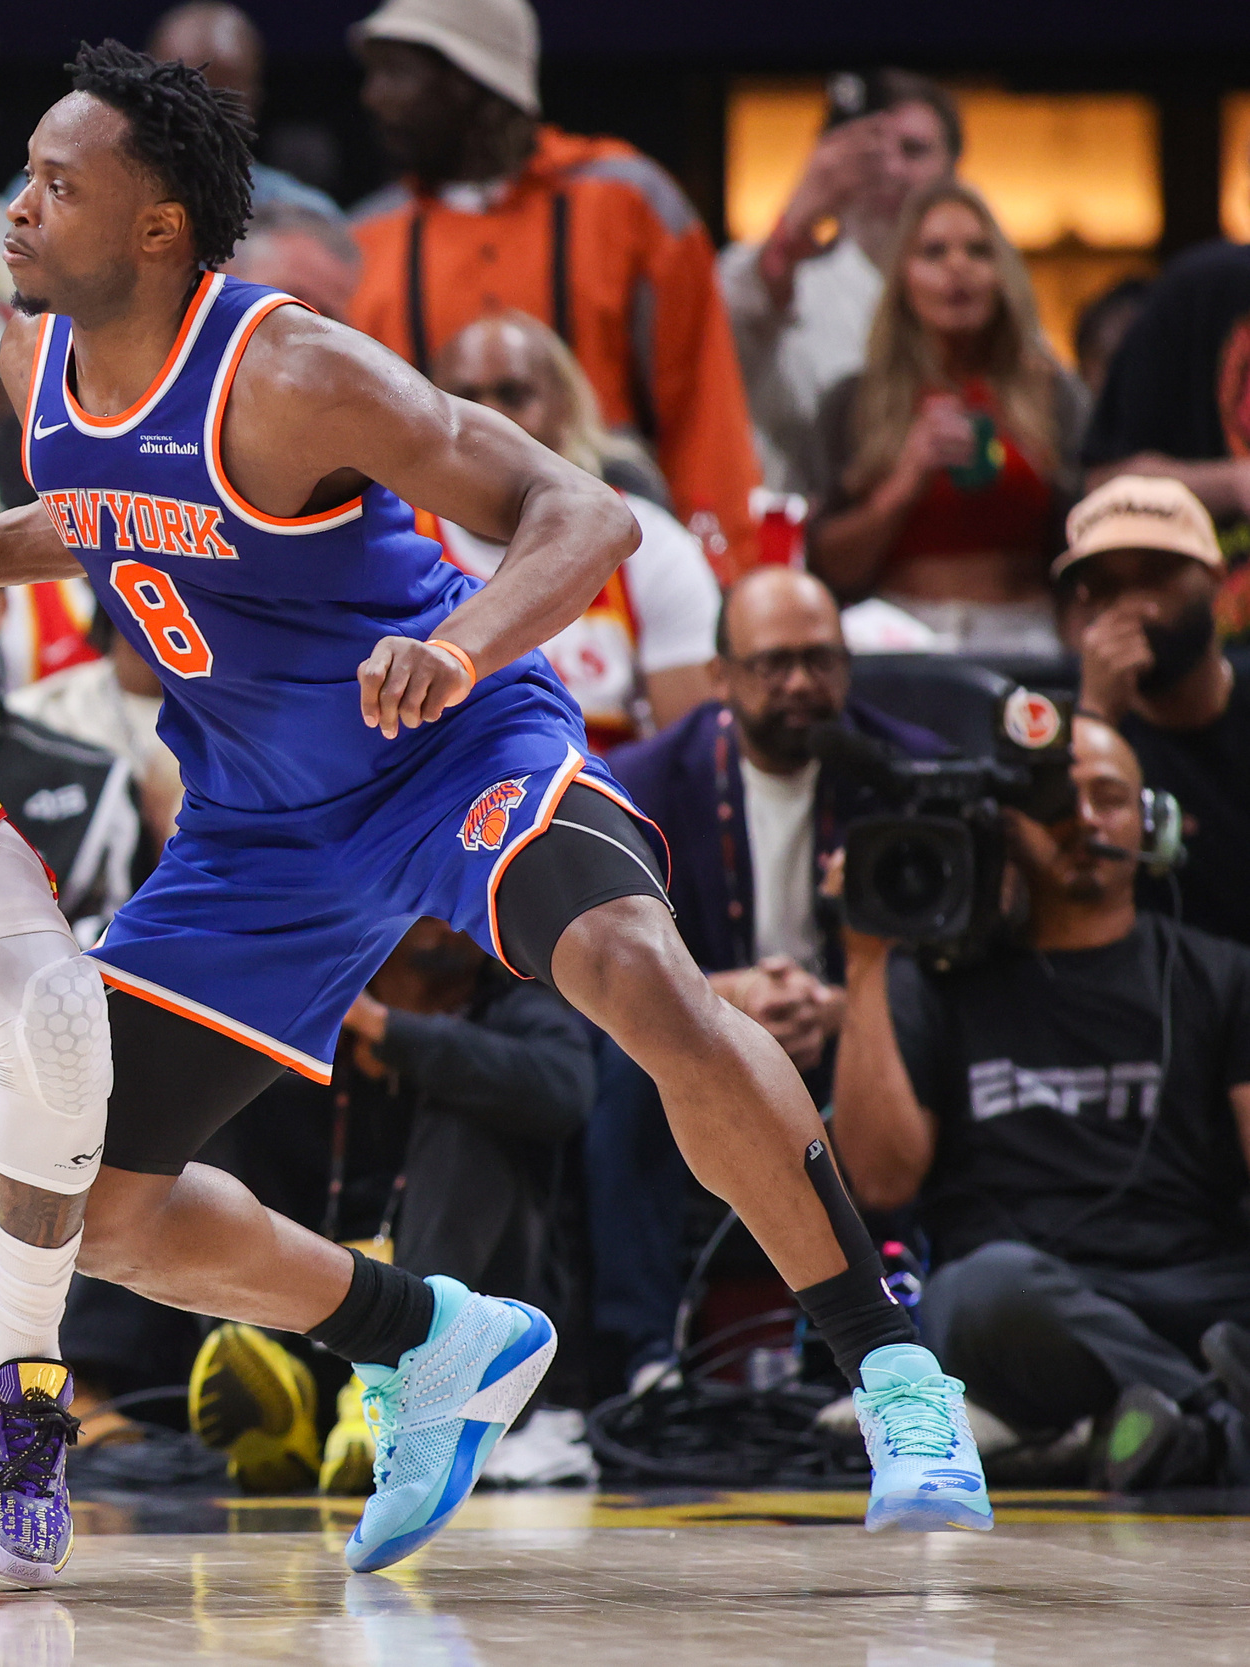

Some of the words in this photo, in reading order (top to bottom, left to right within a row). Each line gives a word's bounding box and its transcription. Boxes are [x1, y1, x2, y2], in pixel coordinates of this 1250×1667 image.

[140, 433, 173, 441] experience
[140, 441, 163, 454] abu
[165, 441, 199, 455] dhabi
[104, 490, 240, 560] YORK
[109, 558, 214, 680] 8
[464, 781, 523, 847] KNICKS
[968, 1059, 1161, 1121] ESPN
